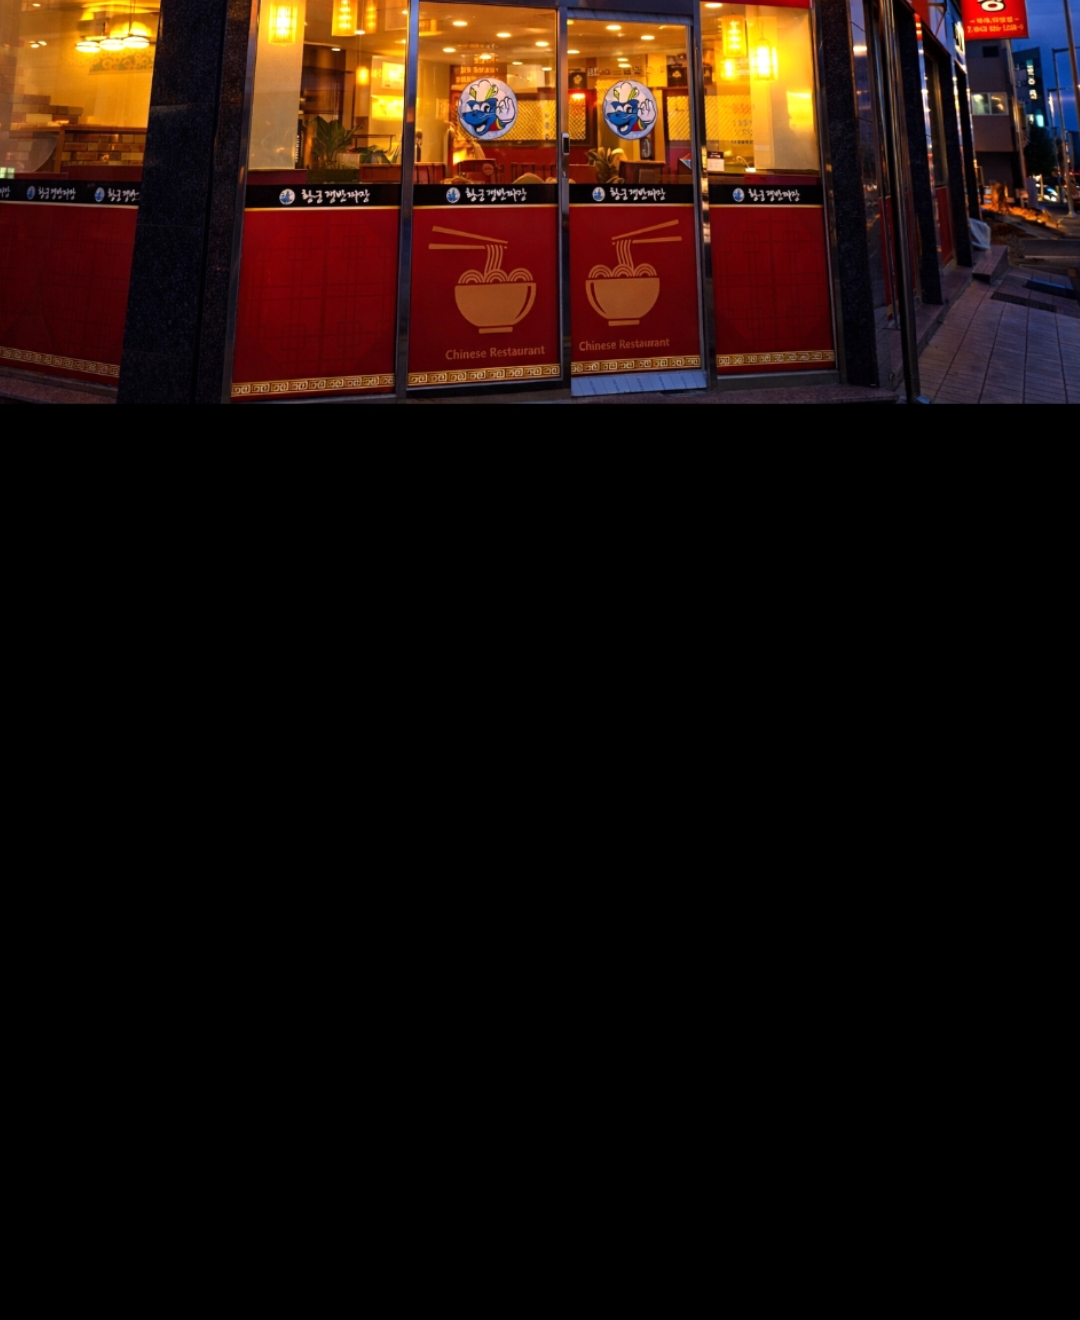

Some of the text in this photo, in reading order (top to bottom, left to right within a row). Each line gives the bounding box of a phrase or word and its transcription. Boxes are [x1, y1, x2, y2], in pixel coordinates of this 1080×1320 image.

[301, 188, 323, 204] 황궁
[465, 187, 486, 203] 황궁
[610, 187, 628, 201] 황궁
[579, 337, 670, 352] Chinese Restaurant
[445, 345, 546, 361] Chinese Restaurant
